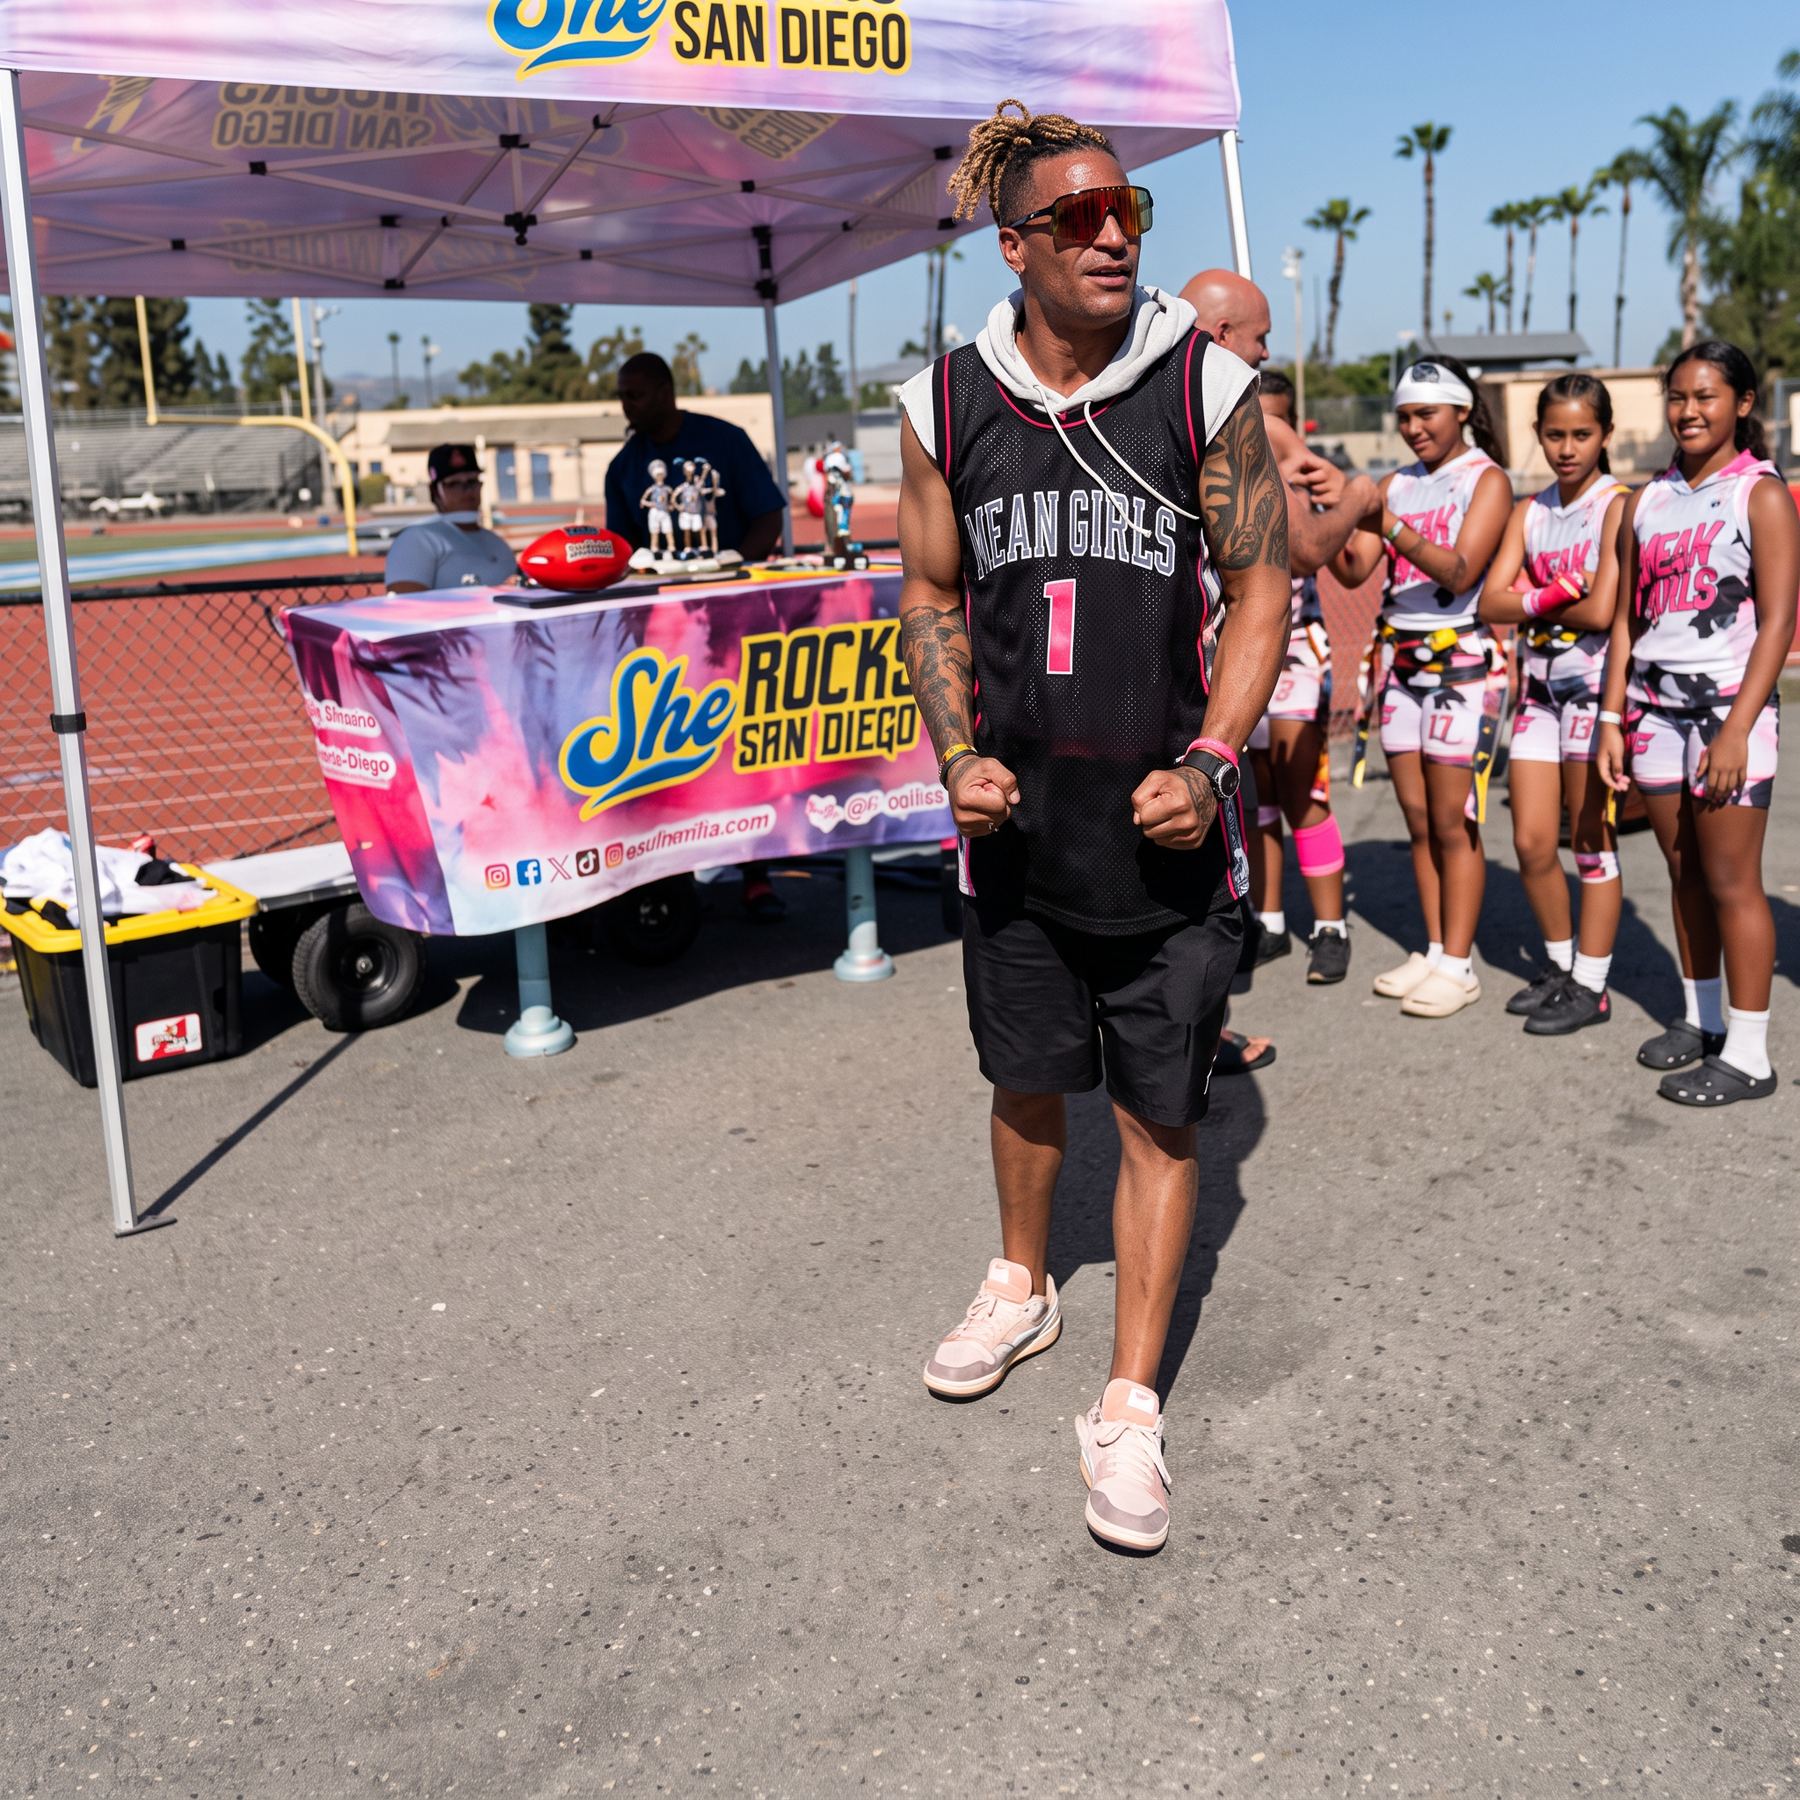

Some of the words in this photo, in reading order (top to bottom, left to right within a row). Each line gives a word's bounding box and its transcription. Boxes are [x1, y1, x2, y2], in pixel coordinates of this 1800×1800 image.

[675, 0, 765, 63] SAN
[781, 7, 906, 69] DIEGO
[964, 490, 1060, 581] MEAN
[1069, 489, 1176, 577] GIRLS
[1043, 578, 1077, 675] 1
[566, 656, 738, 789] She
[739, 716, 807, 768] SAN
[820, 703, 917, 757] DIEGO
[1568, 715, 1595, 741] 13
